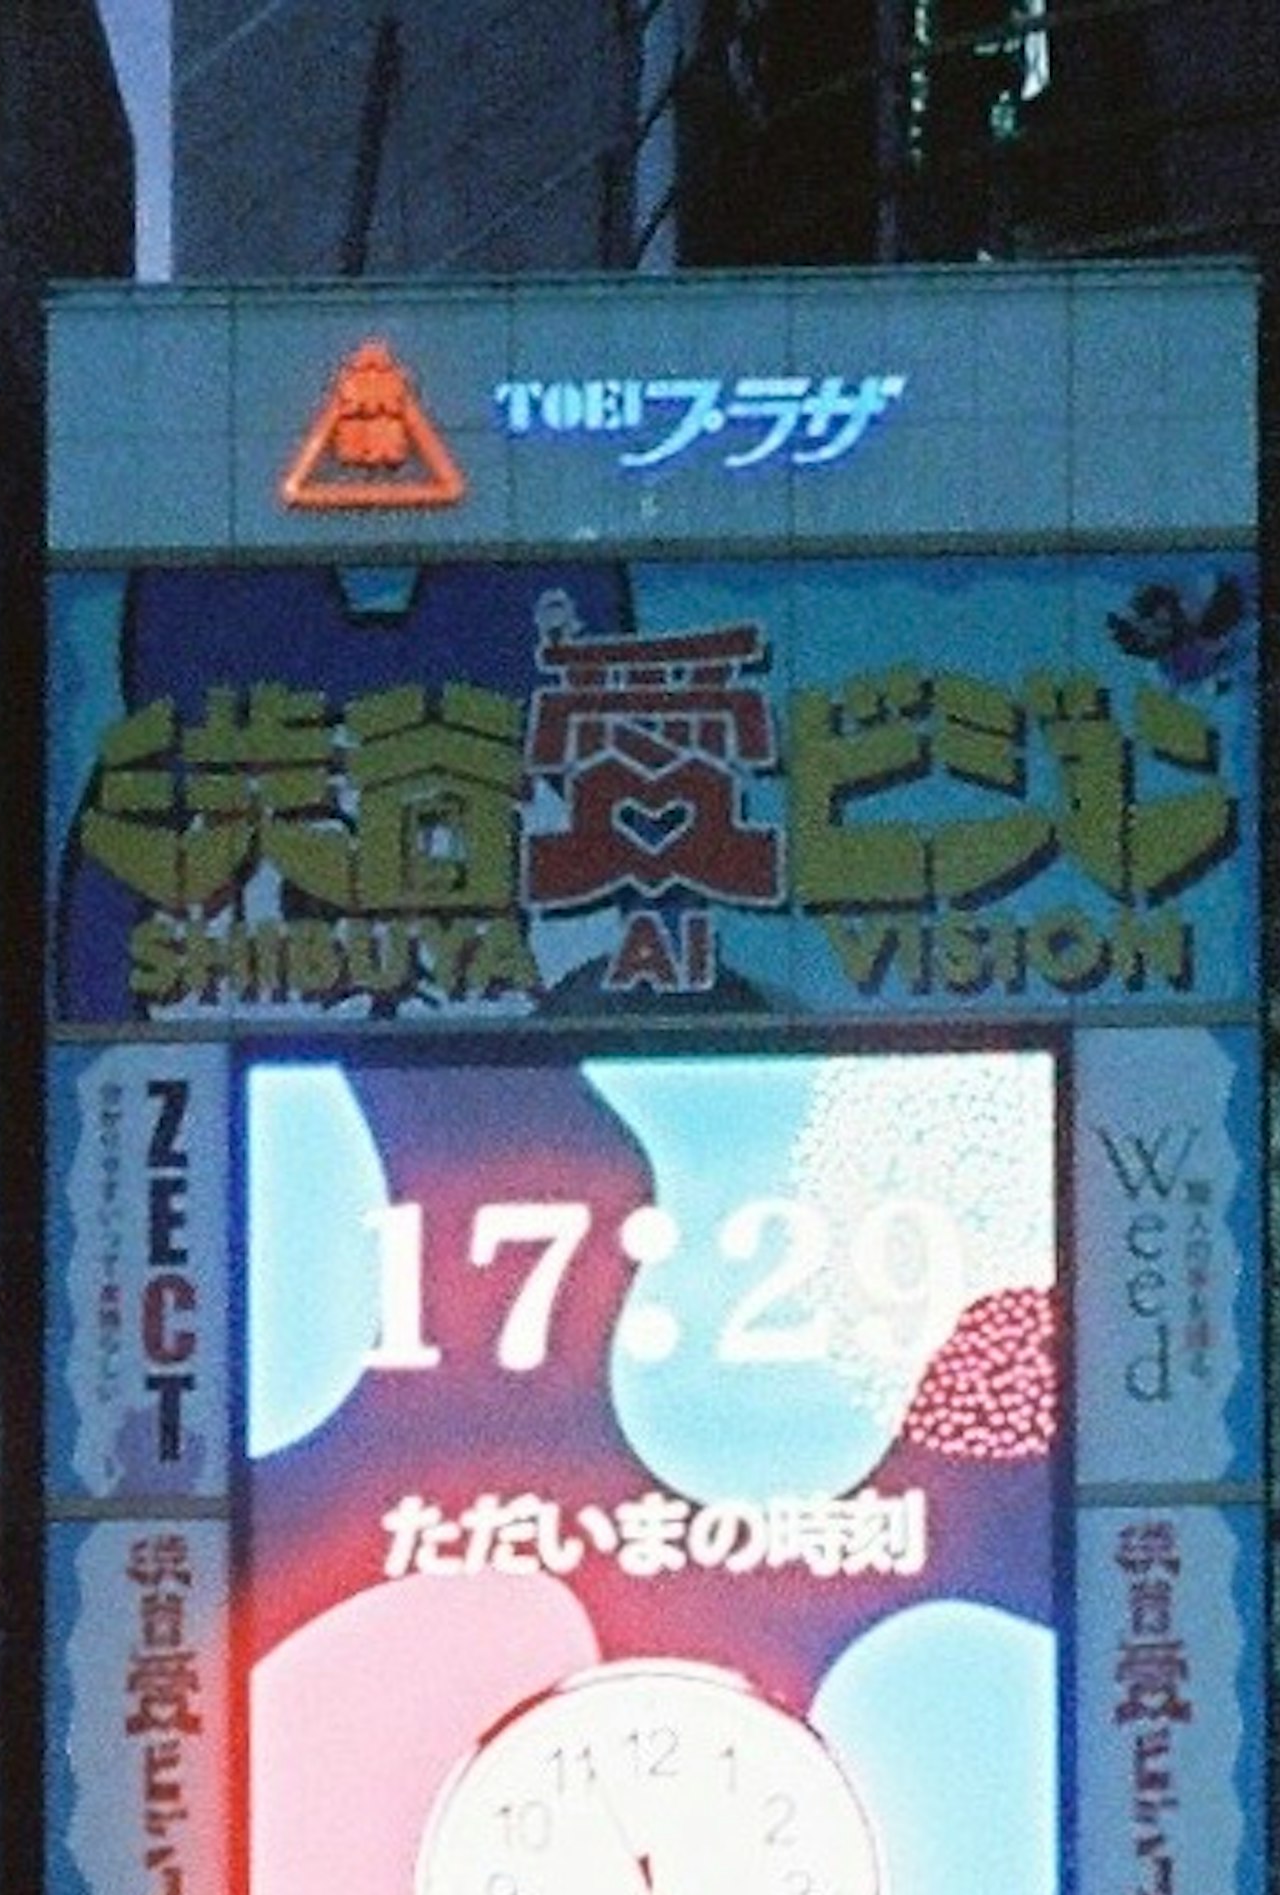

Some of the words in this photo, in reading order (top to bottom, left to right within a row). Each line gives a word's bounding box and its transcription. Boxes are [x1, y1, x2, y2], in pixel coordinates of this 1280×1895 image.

[495, 376, 906, 468] TOEIプラザ
[125, 915, 535, 1002] SHIBUYA
[606, 911, 717, 993] AI
[825, 914, 1197, 994] VISION
[141, 1079, 198, 1463] ZECT
[360, 1200, 966, 1370] 17:29
[381, 1488, 929, 1577] ただいまの時刻
